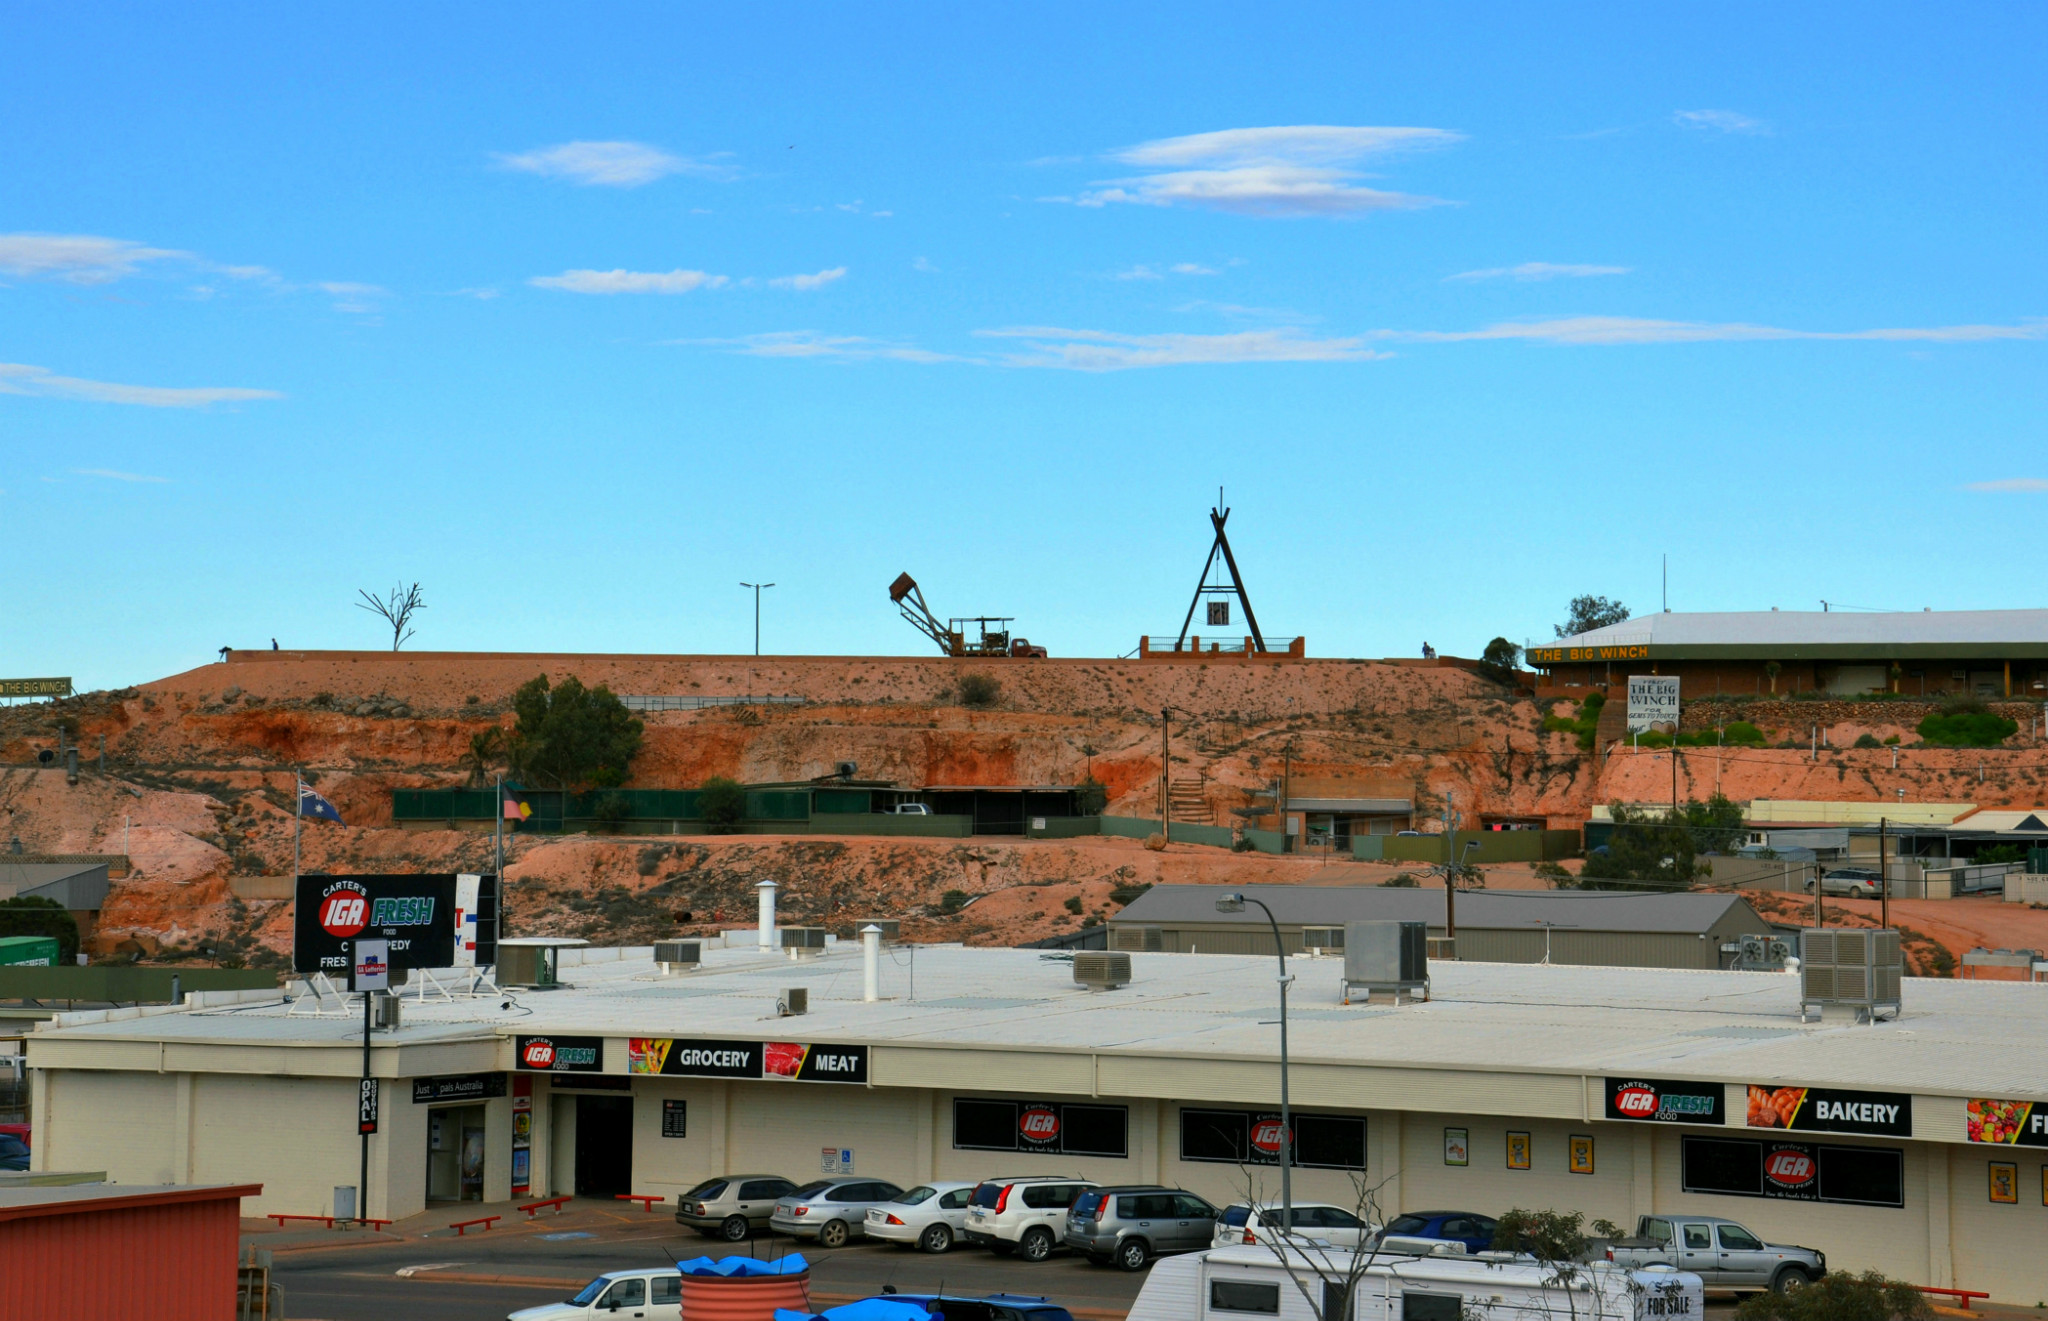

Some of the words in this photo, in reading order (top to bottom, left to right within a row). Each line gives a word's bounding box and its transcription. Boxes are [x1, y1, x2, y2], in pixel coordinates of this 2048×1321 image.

[1534, 649, 1562, 661] THE
[1569, 648, 1594, 660] BIG
[1600, 646, 1649, 659] WINCH
[5, 682, 21, 694] THE
[23, 681, 39, 693] BIG
[40, 681, 67, 692] WINCH
[1630, 684, 1654, 694] THE
[1656, 684, 1676, 695] BIG
[1630, 695, 1676, 706] WINCH
[322, 880, 367, 898] CARTER'S
[323, 899, 365, 927] IGA
[370, 896, 435, 927] FRESH
[382, 928, 397, 936] FOOD
[320, 956, 349, 967] FRES
[525, 1037, 554, 1047] CARTER'S
[526, 1047, 553, 1063] IGA
[555, 1047, 597, 1065] FRESH
[680, 1049, 750, 1068] GROCERY
[815, 1054, 859, 1073] MEAT
[415, 1084, 430, 1095] Just
[454, 1080, 484, 1092] Australia
[1617, 1081, 1657, 1093] CARTER'S
[361, 1080, 371, 1122] OPAL
[1619, 1092, 1655, 1112] IGA
[1658, 1094, 1715, 1116] FRESH
[1655, 1111, 1678, 1121] FOOD
[1815, 1100, 1900, 1124] BAKERY
[1024, 1114, 1056, 1133] IGA
[1771, 1143, 1810, 1153] Carter's
[1770, 1155, 1810, 1177] IGA
[1648, 1297, 1665, 1316] FOR
[1667, 1296, 1690, 1315] SALE
